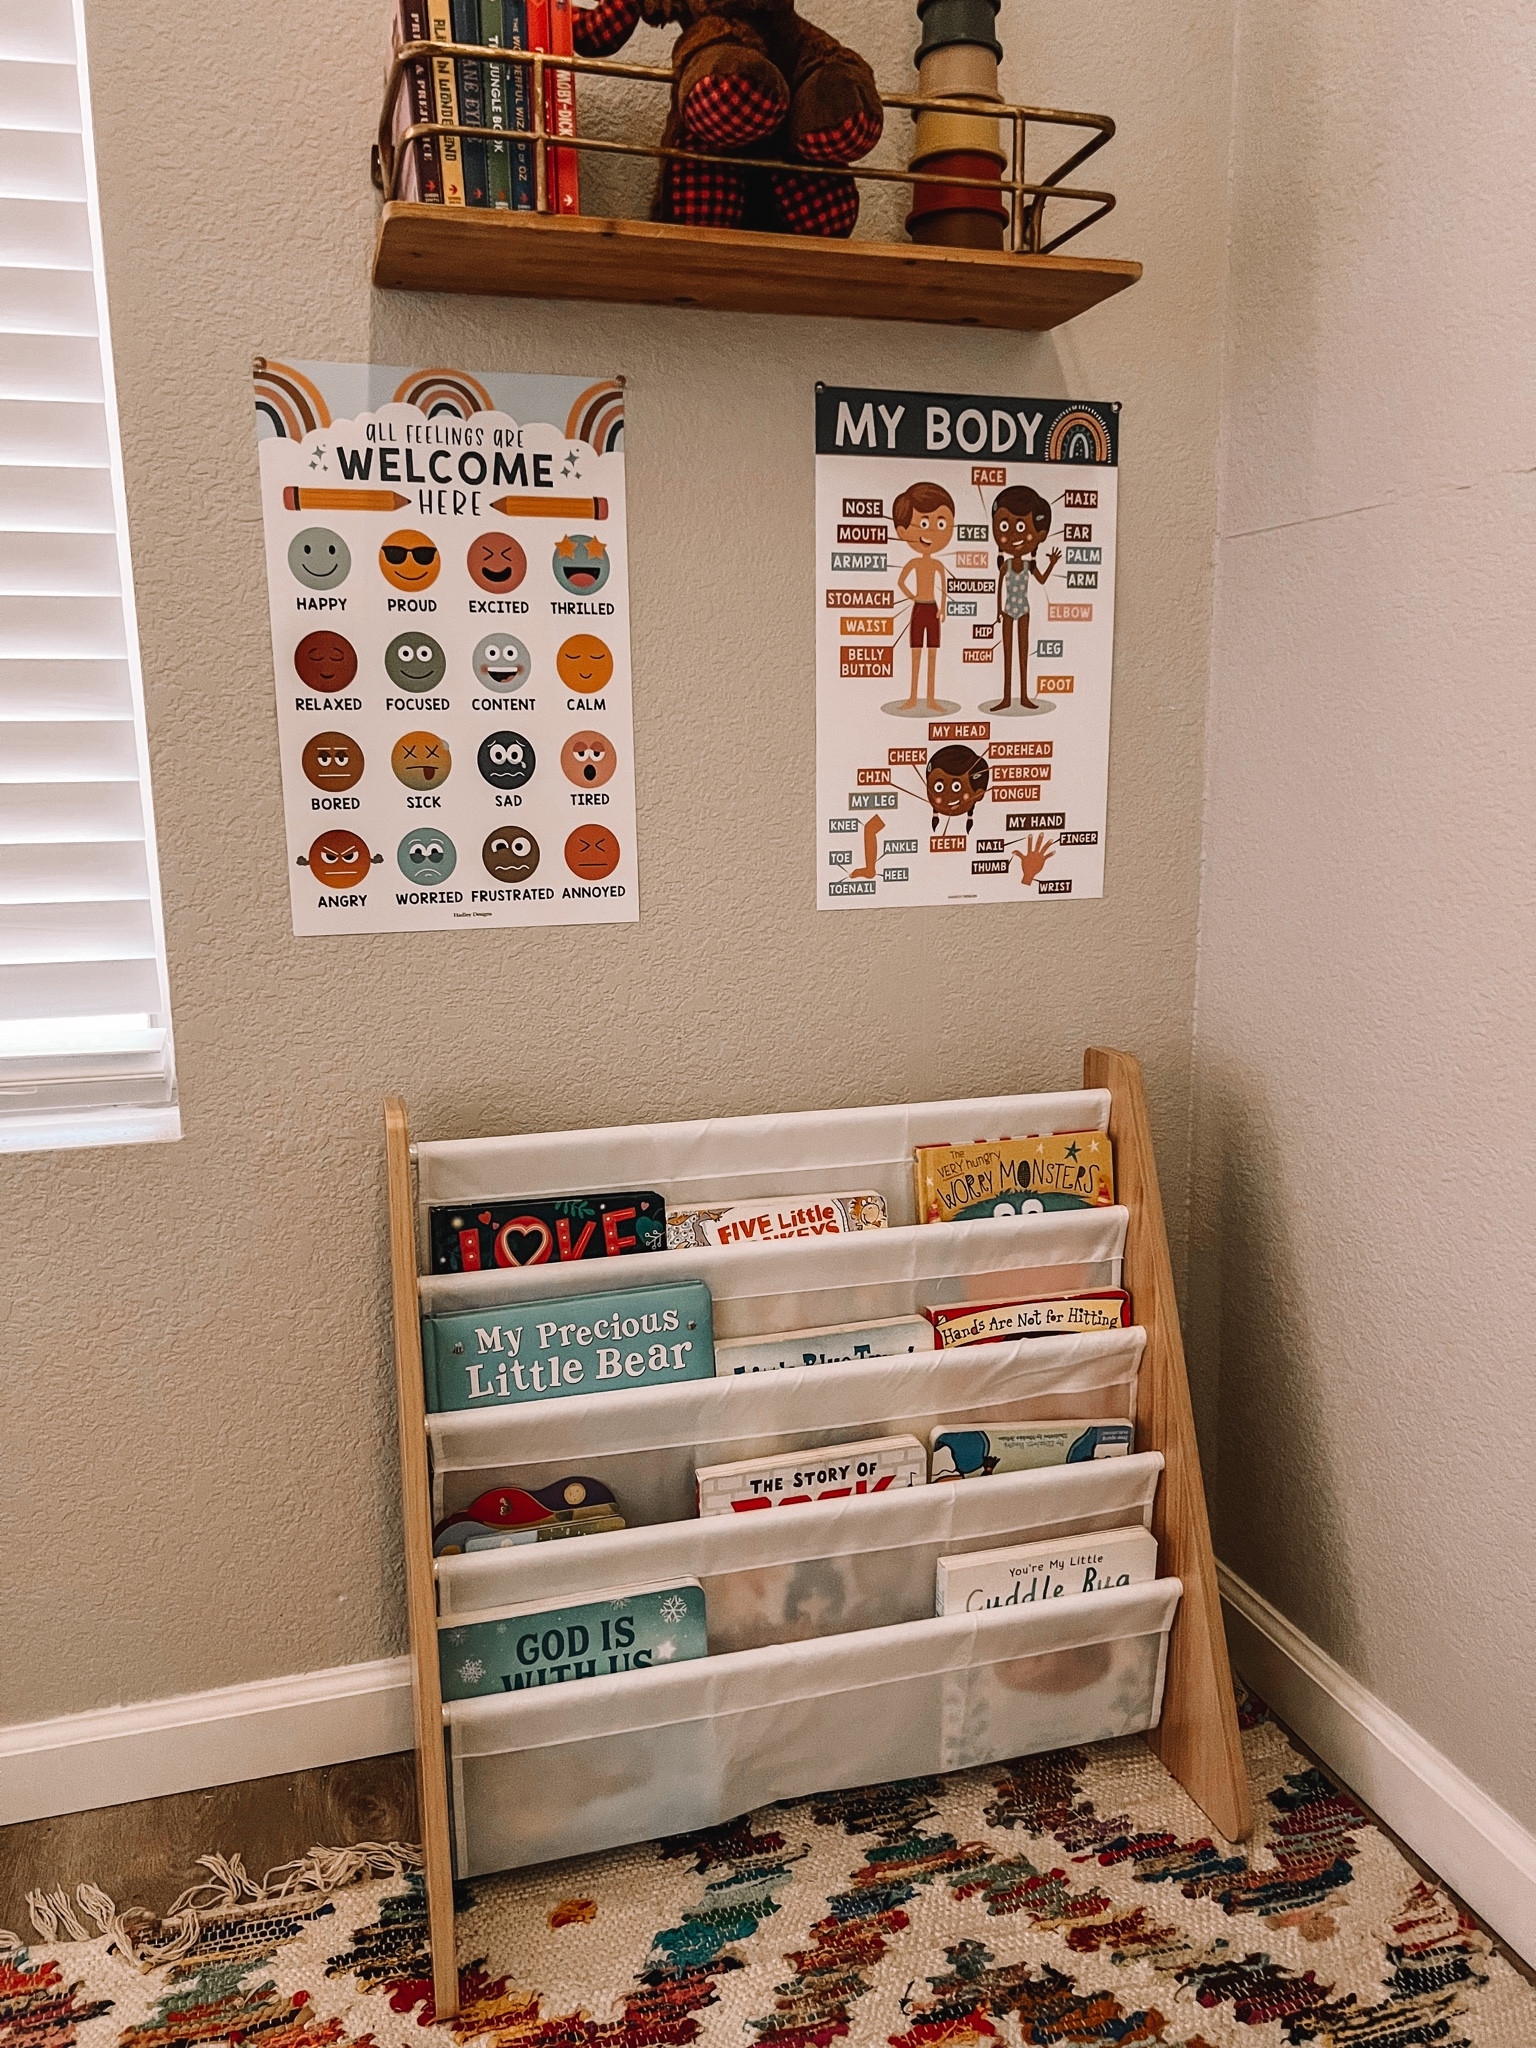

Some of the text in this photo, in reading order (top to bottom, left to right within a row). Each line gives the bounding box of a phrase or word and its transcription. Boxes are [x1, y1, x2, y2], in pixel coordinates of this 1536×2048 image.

[489, 63, 502, 112] JUNGLE
[556, 69, 573, 137] MOBY-DICK
[417, 80, 432, 161] PREJUICE
[518, 166, 527, 181] OZ
[835, 401, 1043, 455] MY BODY
[406, 424, 484, 446] FEELINGS
[337, 447, 554, 488] WELCOME
[974, 469, 1003, 483] FACE
[418, 489, 481, 516] HERE
[1066, 493, 1097, 506] HAIR
[846, 501, 880, 515] NOSE
[839, 527, 886, 541] MOUTH
[959, 527, 987, 539] EYES
[1065, 526, 1089, 539] EAR
[833, 555, 887, 569] ARMPIT
[957, 553, 987, 566] NECK
[1067, 550, 1100, 562] PALM
[948, 581, 995, 592] SHOULDER
[1068, 574, 1096, 586] ARM
[296, 598, 347, 611] HAPPY
[388, 599, 437, 612] PROUD
[828, 593, 891, 606] STOMACH
[469, 601, 529, 614] EXCITED
[551, 602, 615, 615] THRILLED
[948, 604, 975, 615] CHEST
[1050, 606, 1090, 619] ELBOW
[846, 619, 887, 633] WAIST
[975, 626, 992, 637] HIP
[848, 649, 884, 661] BELLY
[1039, 642, 1061, 655] LEG
[964, 650, 992, 662] THIGH
[841, 663, 891, 675] BUTTON
[1039, 679, 1072, 691] FOOT
[295, 698, 362, 711] RELAXED
[386, 698, 450, 711] FOCUSED
[472, 698, 535, 711] CONTENT
[567, 698, 606, 711] CALM
[932, 725, 986, 737] MY HEAD
[889, 750, 926, 763] CHEEK
[990, 744, 1051, 757] FOREHEAD
[858, 771, 890, 783] CHIN
[994, 767, 1049, 779] EYEBROW
[570, 793, 609, 805] TIRED
[994, 788, 1038, 800] TONGUE
[311, 798, 360, 810] BORED
[407, 796, 441, 809] SICK
[495, 795, 522, 807] SAD
[852, 795, 895, 807] MY LEG
[830, 820, 856, 831] KNEE
[1009, 816, 1063, 827] MY HAND
[931, 838, 965, 850] TEETH
[1061, 833, 1097, 844] FINGER
[885, 841, 917, 852] ANKLE
[978, 841, 1003, 851] NAIL
[831, 853, 850, 863] TOE
[973, 862, 1007, 872] THUMB
[885, 870, 907, 880] HEEL
[562, 886, 626, 899] ANNOYED
[829, 883, 875, 894] TOENAIL
[1040, 882, 1071, 892] WRIST
[318, 895, 367, 908] ANGRY
[396, 891, 463, 905] WORRIED
[471, 888, 554, 902] FRUSTRATED
[937, 1151, 1000, 1178] VERY hungry
[937, 1159, 1099, 1209] WORRY MONSTERS
[718, 1205, 834, 1244] FIVE Little
[475, 1308, 680, 1357] My Precious
[942, 1308, 1118, 1345] Hands Are Not for Hitting
[465, 1339, 693, 1399] Little Bear
[750, 1478, 782, 1494] THE
[793, 1465, 850, 1487] STORY
[857, 1462, 877, 1476] OF
[1009, 1555, 1103, 1577] You're My Little
[966, 1575, 1064, 1612] Cuddle
[516, 1616, 635, 1665] GOD IS
